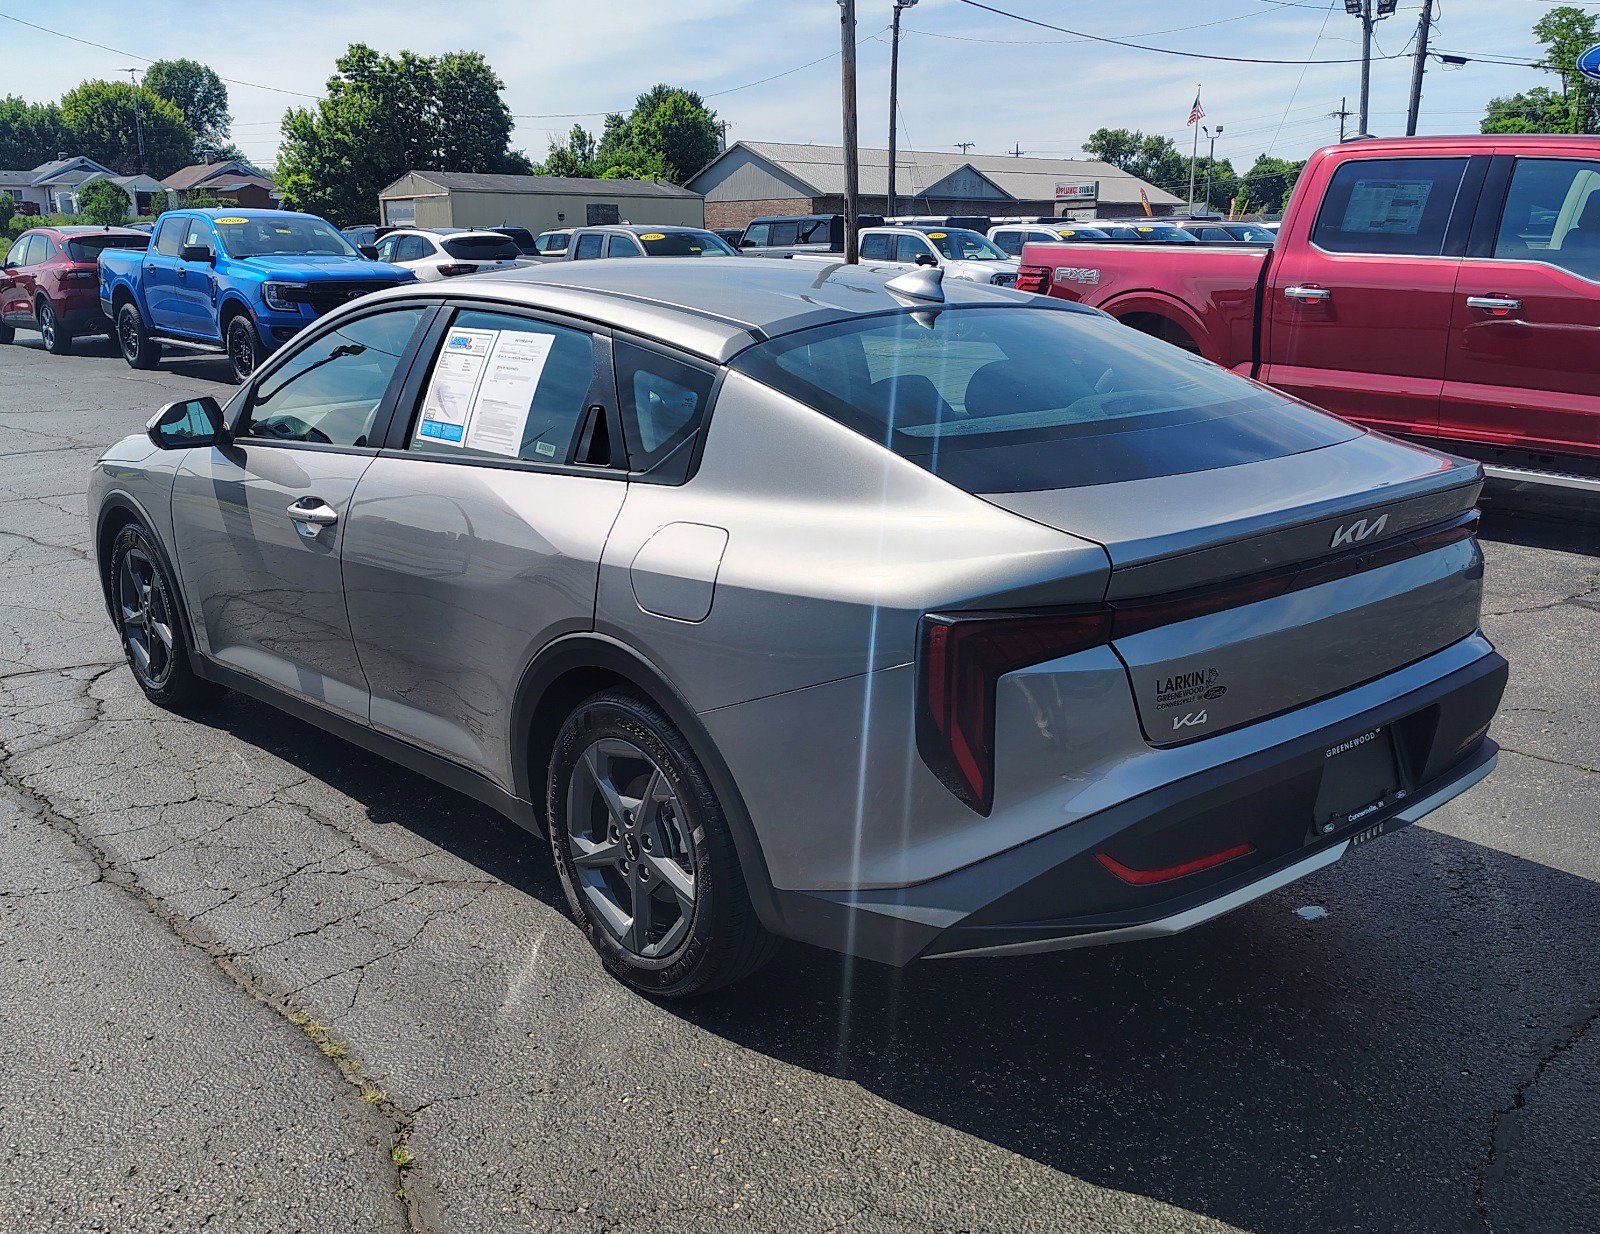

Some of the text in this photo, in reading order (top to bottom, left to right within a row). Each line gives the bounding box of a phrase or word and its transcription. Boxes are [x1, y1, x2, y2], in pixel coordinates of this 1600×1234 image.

[1055, 186, 1094, 195] APPLIANCE STUDIO
[1055, 266, 1100, 282] FX4
[1330, 513, 1389, 548] KIA
[1156, 670, 1205, 694] LARKIN
[1156, 685, 1204, 703] GREENEWOOD
[1173, 709, 1207, 730] K4
[1325, 732, 1375, 757] GREENEWOOD
